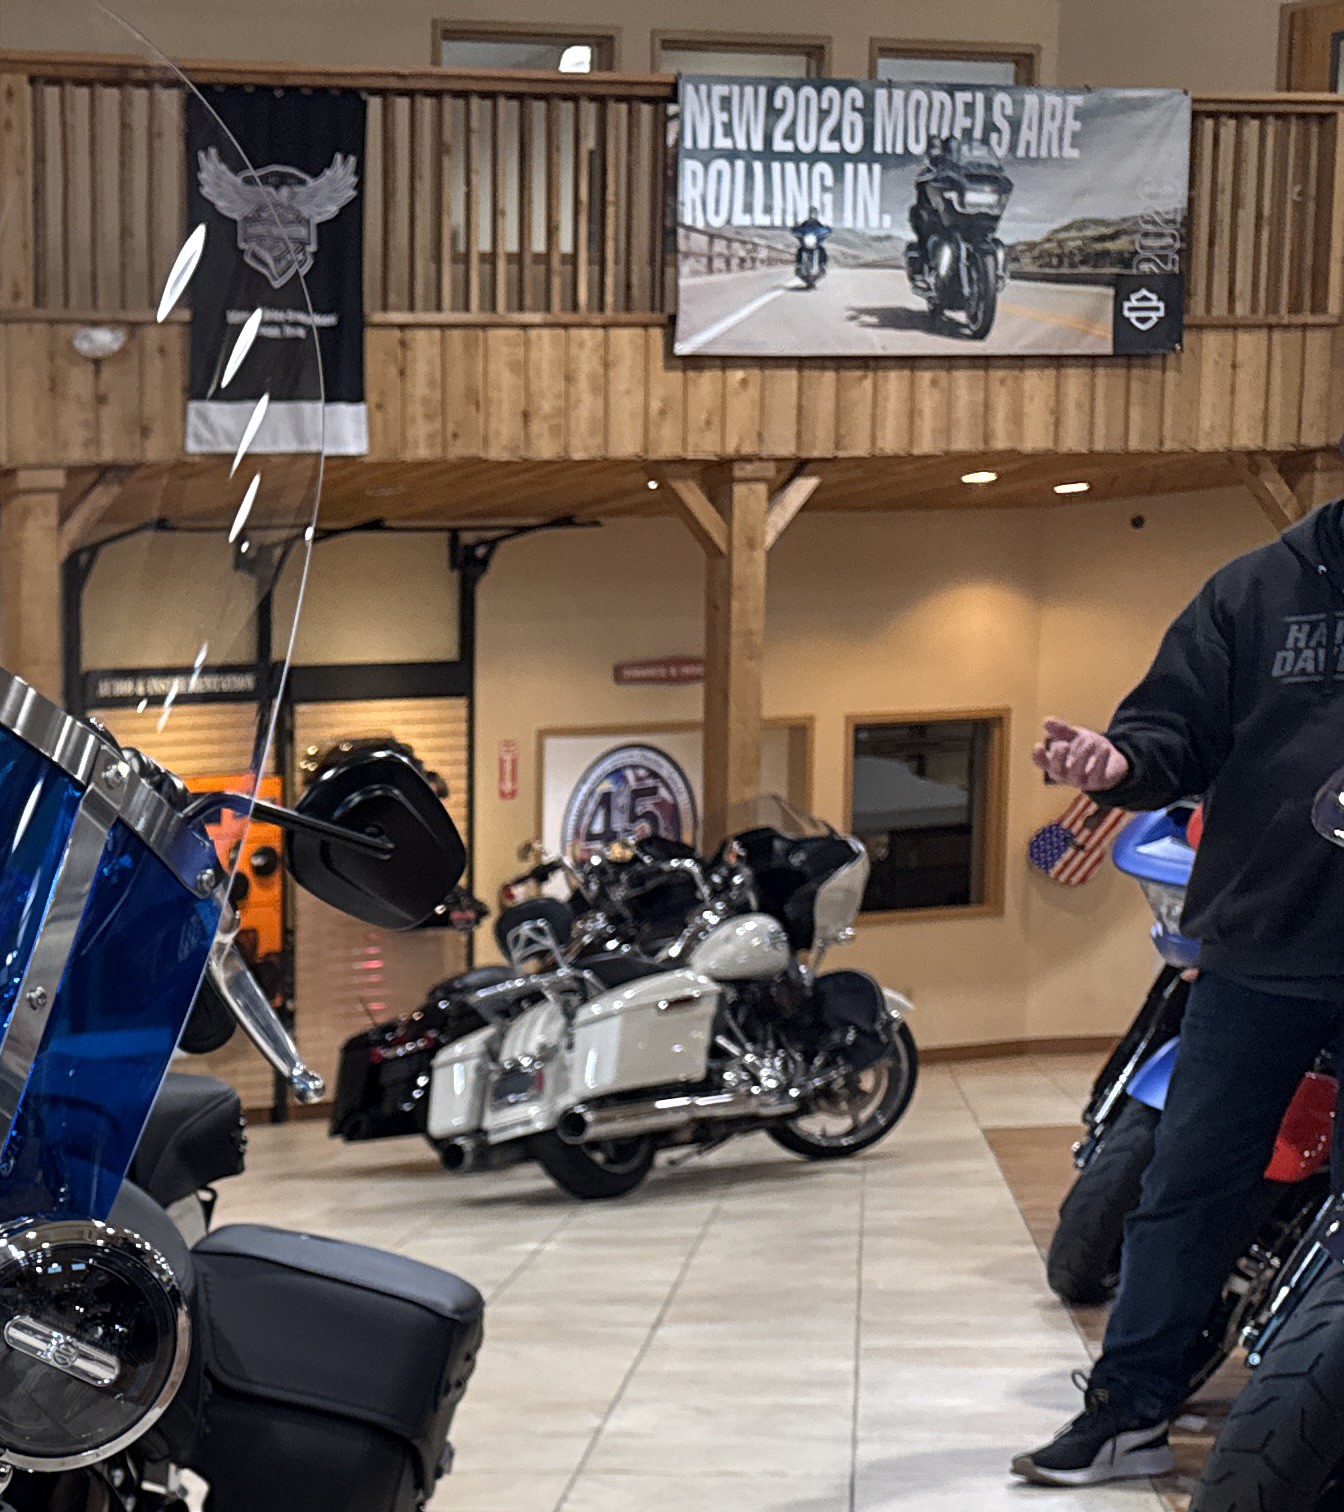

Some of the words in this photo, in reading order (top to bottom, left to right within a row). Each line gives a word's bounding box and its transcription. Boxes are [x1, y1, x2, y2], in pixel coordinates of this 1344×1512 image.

[684, 83, 769, 152] NEW
[772, 85, 865, 155] 2026
[873, 87, 1014, 158] MODELS
[1016, 93, 1084, 158] ARE
[683, 157, 835, 229] ROLLING
[843, 159, 891, 230] IN.
